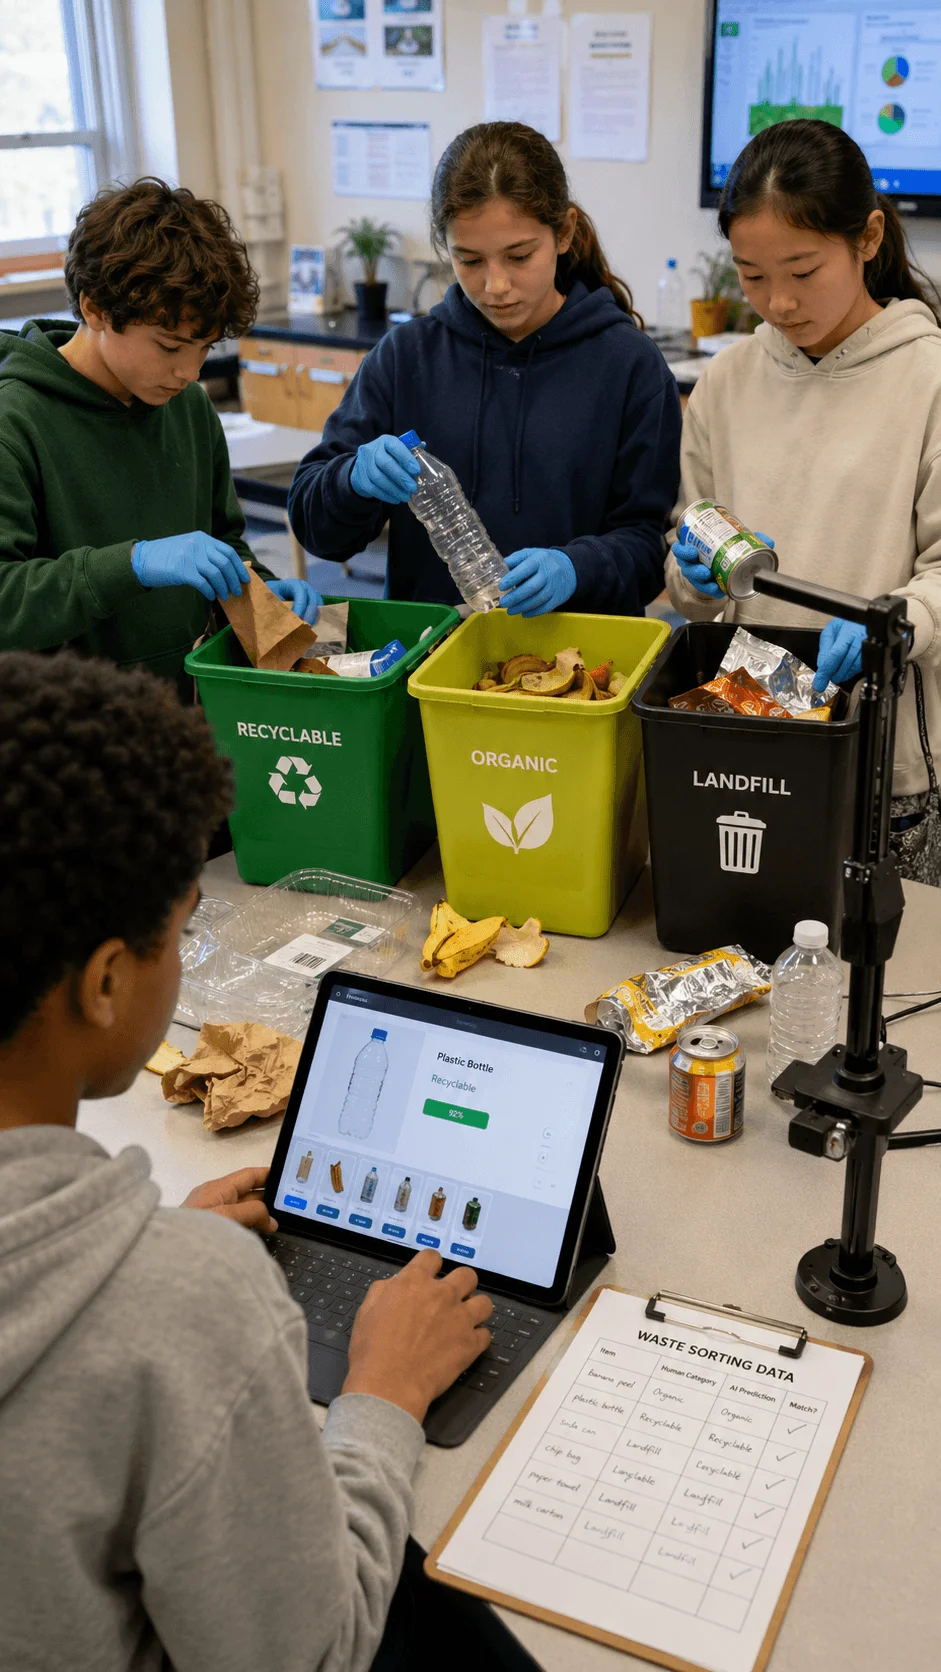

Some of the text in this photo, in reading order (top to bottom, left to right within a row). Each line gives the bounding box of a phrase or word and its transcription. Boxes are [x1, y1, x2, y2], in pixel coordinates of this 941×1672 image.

[236, 721, 342, 748] RECYCLABLE
[470, 749, 558, 774] ORGANIC
[692, 770, 792, 796] LANDFILL
[436, 1051, 494, 1073] Plastic Bottle
[431, 1073, 476, 1093] Recyclable
[448, 1109, 464, 1119] 92%
[600, 1347, 617, 1357] Item
[637, 1329, 796, 1384] WASTE SORTING DATA
[616, 1377, 637, 1389] peel
[661, 1365, 718, 1387] Human Category
[652, 1387, 685, 1403] Organic
[729, 1384, 777, 1403] AI Prediction
[572, 1393, 625, 1415] plastic bottle
[788, 1401, 819, 1415] Match?
[639, 1412, 683, 1432] Recyclable
[720, 1407, 753, 1423] Organic
[708, 1432, 753, 1453] Recyclable
[528, 1470, 581, 1492] paper towel
[513, 1498, 533, 1510] milk
[598, 1493, 637, 1512] Landfill
